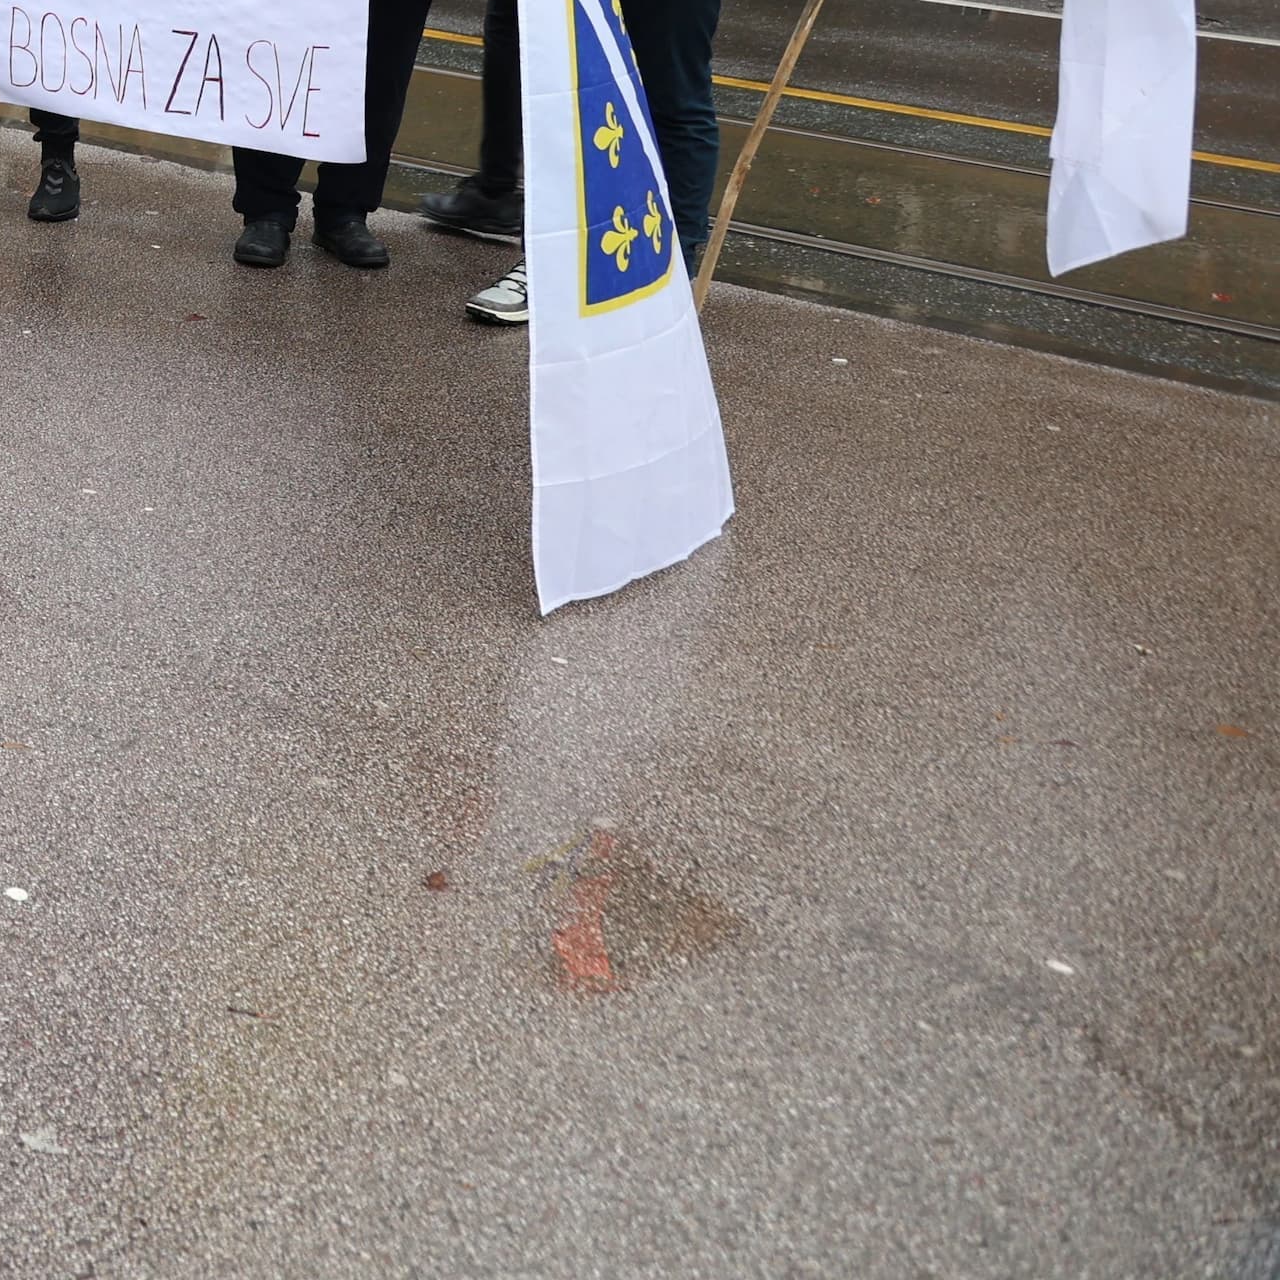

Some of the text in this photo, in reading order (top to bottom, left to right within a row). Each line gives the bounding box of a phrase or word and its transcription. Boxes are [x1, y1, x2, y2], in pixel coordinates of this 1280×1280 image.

[9, 6, 331, 138] BOSNA ZA SVE
